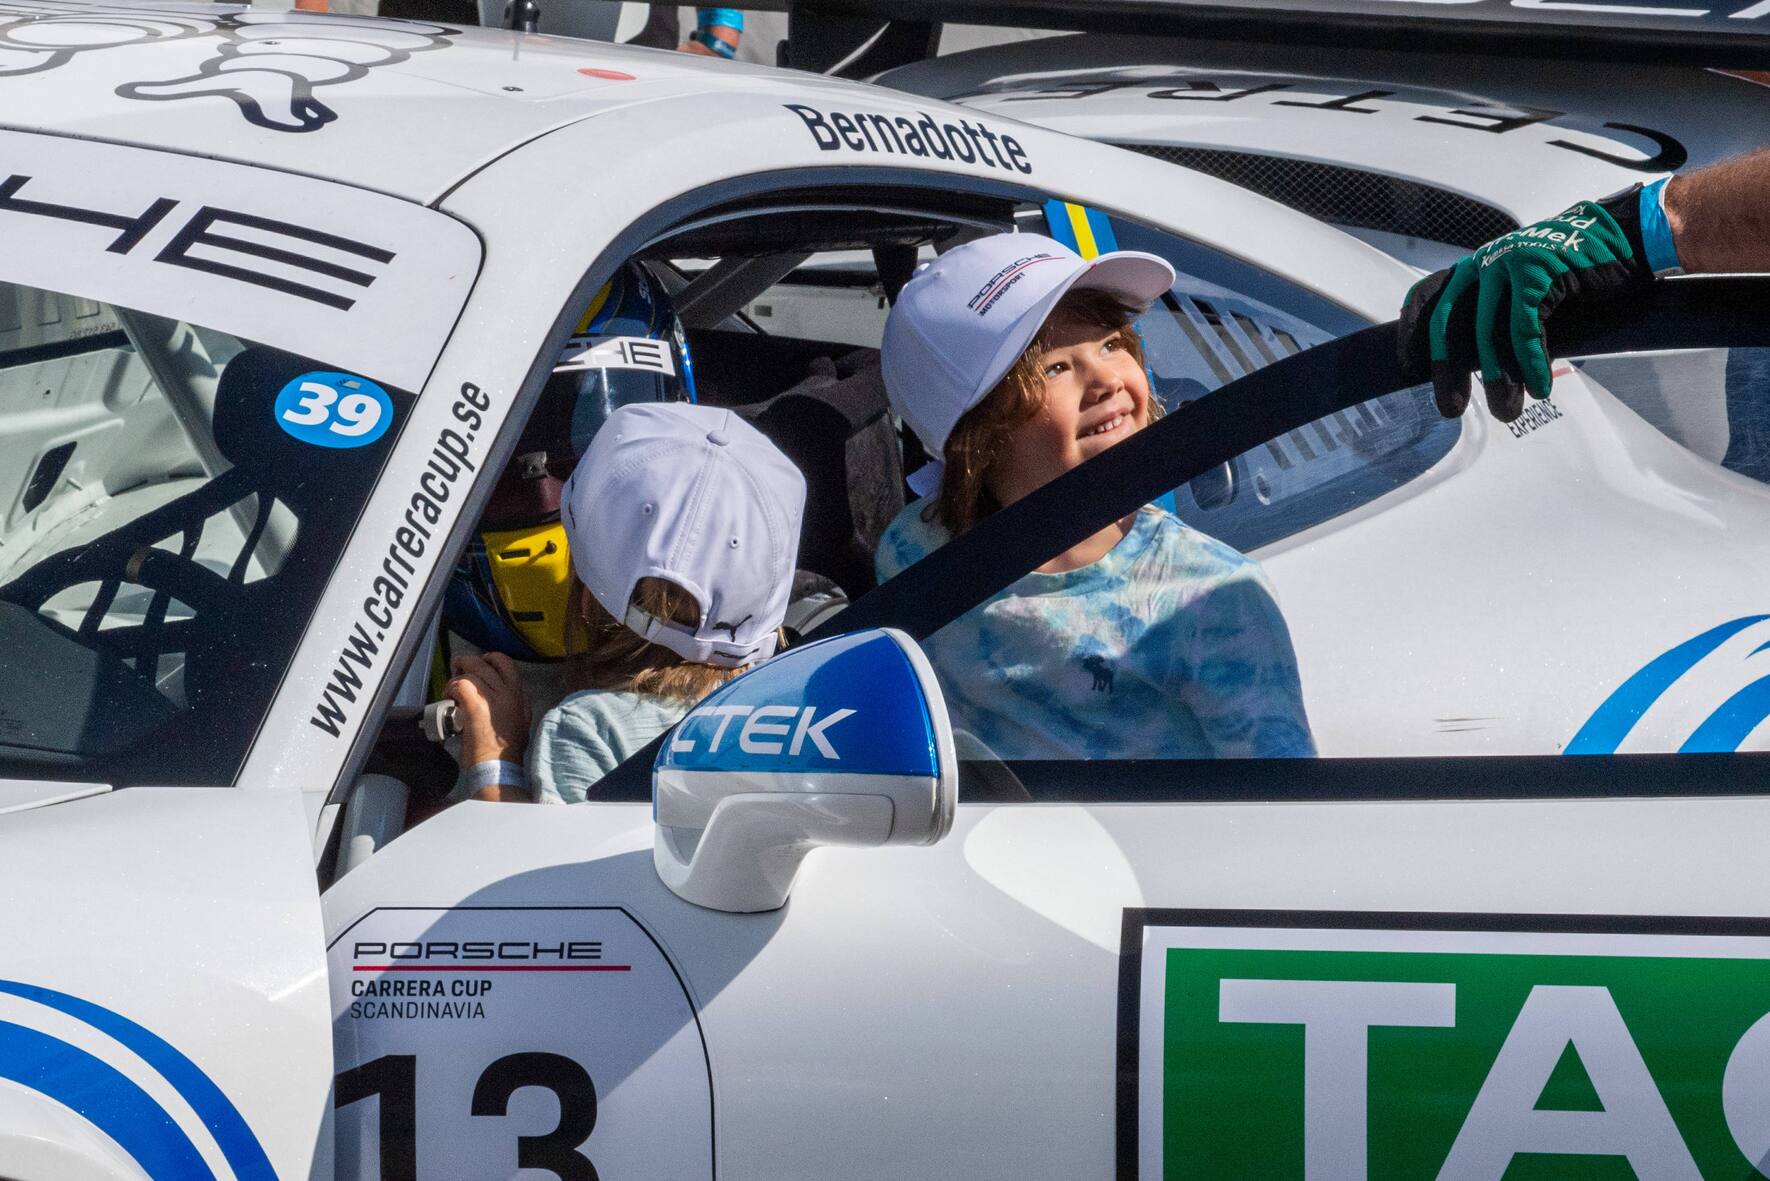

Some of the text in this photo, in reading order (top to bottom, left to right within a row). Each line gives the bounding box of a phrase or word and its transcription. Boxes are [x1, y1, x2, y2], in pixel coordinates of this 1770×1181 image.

[783, 104, 1032, 174] Bernadotte
[282, 382, 382, 436] 39
[310, 381, 490, 738] www.carreracup.se
[671, 705, 857, 760] CTEK
[353, 942, 602, 960] PORSCHE
[350, 1002, 485, 1019] SCANDINAVIA
[351, 980, 492, 998] CARRERA CUP
[1219, 978, 1770, 1181] TA
[334, 1052, 599, 1181] 13
